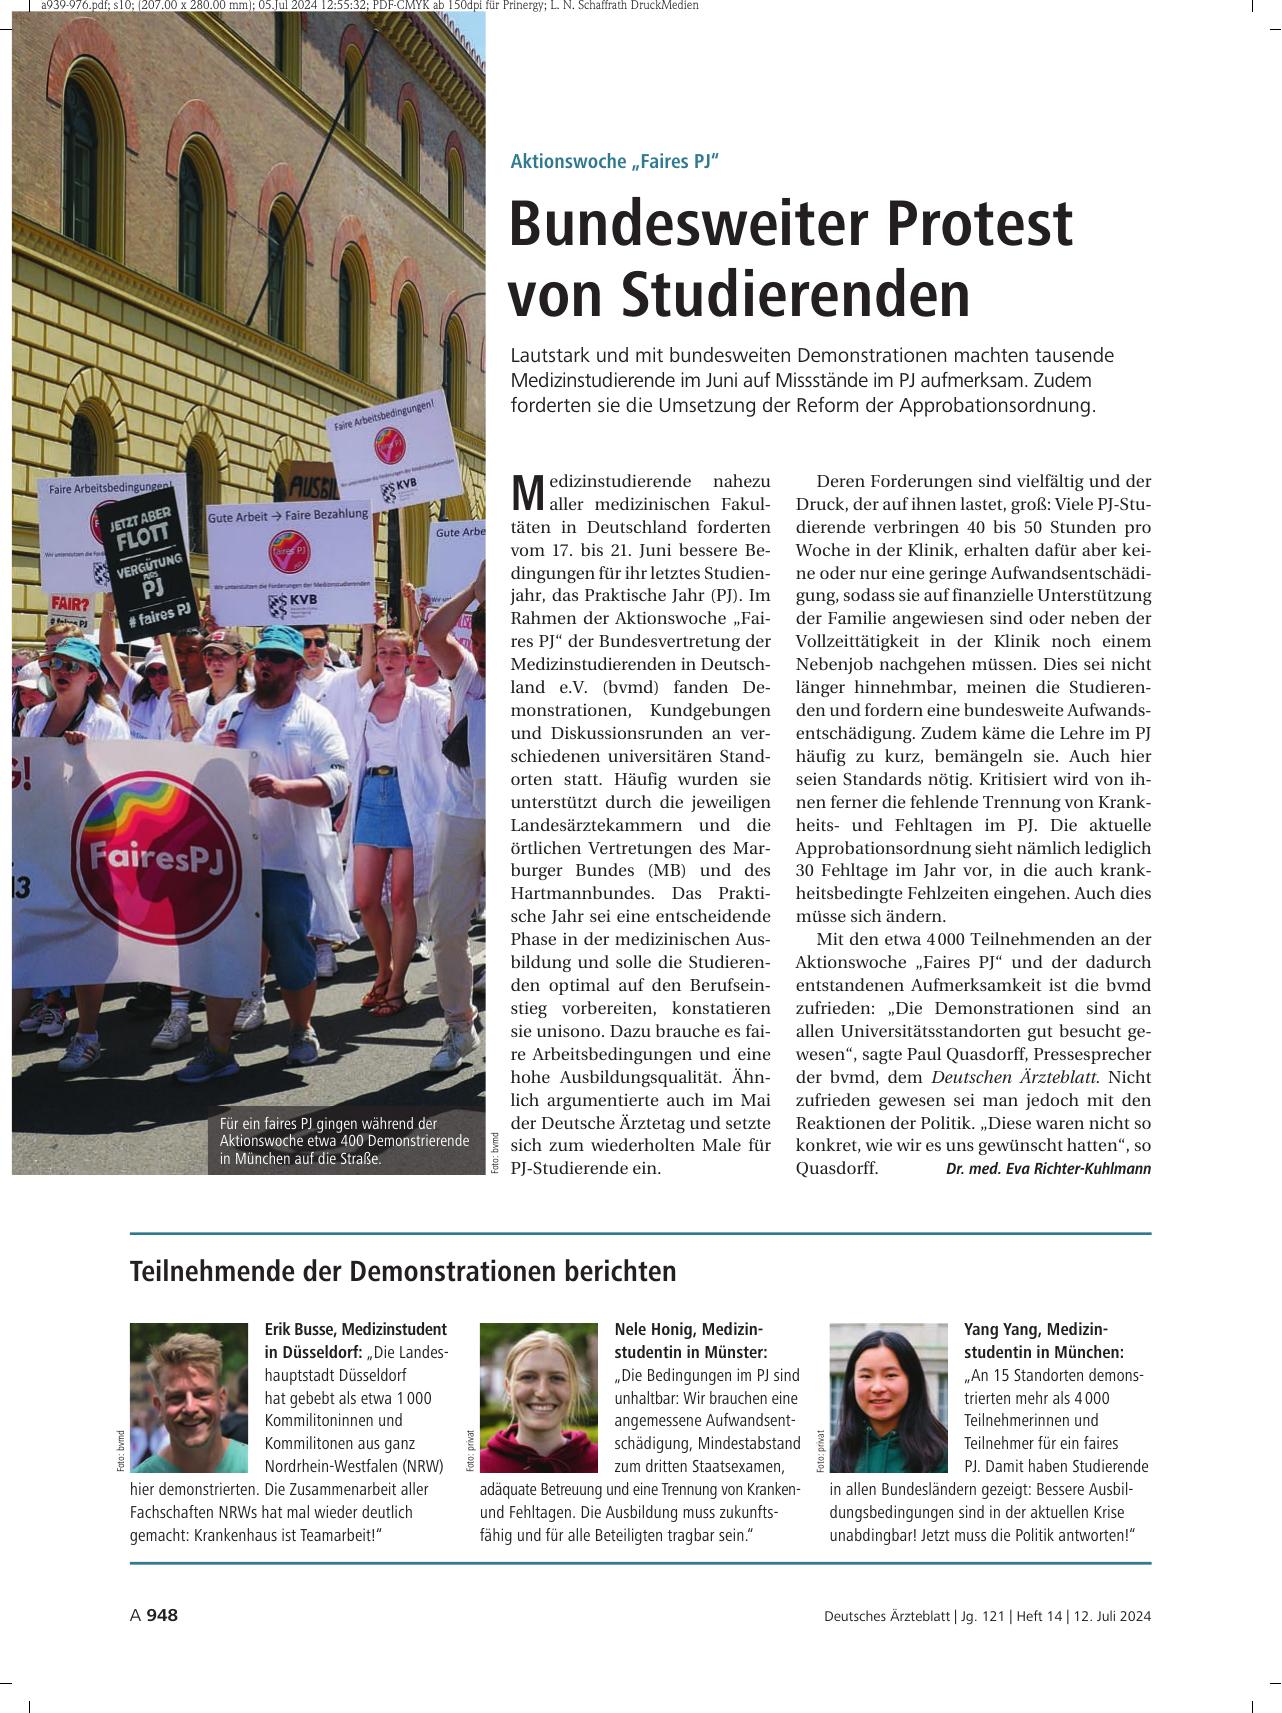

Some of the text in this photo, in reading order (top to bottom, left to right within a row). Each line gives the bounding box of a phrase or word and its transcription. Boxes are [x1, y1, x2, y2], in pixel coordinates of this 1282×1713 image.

[42, 0, 110, 11] a939-976.pdf;
[114, 0, 134, 10] s10;
[139, 0, 177, 11] (207.00
[190, 0, 225, 9] 280.00
[230, 0, 255, 11] mm);
[259, 0, 287, 10] 05.Jul
[292, 0, 317, 9] 2024
[323, 0, 369, 11] 12:55:32;
[373, 0, 429, 9] PDF-CMYK
[434, 0, 444, 9] ab
[450, 0, 482, 11] 150dpi
[486, 0, 499, 9] für
[504, 0, 546, 11] Prinergy;
[551, 0, 559, 9] L.
[564, 0, 574, 9] N.
[579, 0, 627, 9] Schaffrath
[631, 0, 698, 9] DruckMedien
[511, 153, 719, 171] Aktionswoche „Faires PJ“
[512, 197, 1073, 246] Bundesweiter Protest
[508, 268, 968, 317] von Studierenden
[512, 347, 1114, 362] Lautstark und mit bundesweiten Demonstrationen machten tausende
[335, 399, 434, 431] Faire Arbeitsbedingungen!
[49, 484, 72, 495] Faire
[397, 478, 417, 491] KVB
[111, 515, 138, 533] JETZT
[142, 507, 170, 524] ABER
[208, 507, 369, 524] Gute Arbeit Faire Bezahlung
[117, 523, 167, 551] FLOTT
[436, 529, 460, 538] Gute
[511, 543, 770, 558] vom 17. bis 21. Juni bessere Be-
[116, 553, 183, 579] VERGÜTUNG
[142, 577, 164, 600] PJ
[51, 595, 89, 612] FAIR?
[290, 594, 318, 605] KVB
[129, 602, 192, 628] # faires PJ
[511, 611, 770, 626] Rahmen der Aktionswoche „Fai-
[90, 840, 225, 876] FairesPJ
[795, 841, 1151, 858] Approbationsordnung sieht nämlich lediglich
[796, 1161, 1151, 1177] Quasdorff. Dr. med. Eva Richter-Kuhlmann
[130, 1259, 675, 1282] Teilnehmende der Demonstrationen berichten
[266, 1322, 447, 1338] Erik Busse, Medizinstudent
[616, 1322, 763, 1339] Nele Honig, Medizin-
[964, 1322, 1108, 1339] Yang Yang, Medizin-
[265, 1345, 448, 1360] in Düsseldorf: „Die Landes-
[615, 1345, 767, 1358] studentin in Münster:
[965, 1345, 1123, 1358] studentin in München:
[116, 1431, 124, 1451] bvmd
[817, 1430, 826, 1452] privat
[466, 1430, 476, 1471] Foto: privat
[130, 1609, 178, 1621] A 948
[825, 1609, 1151, 1624] Deutsches Ärzteblatt Jg. 121 Heft 14 12. Juli 2024
